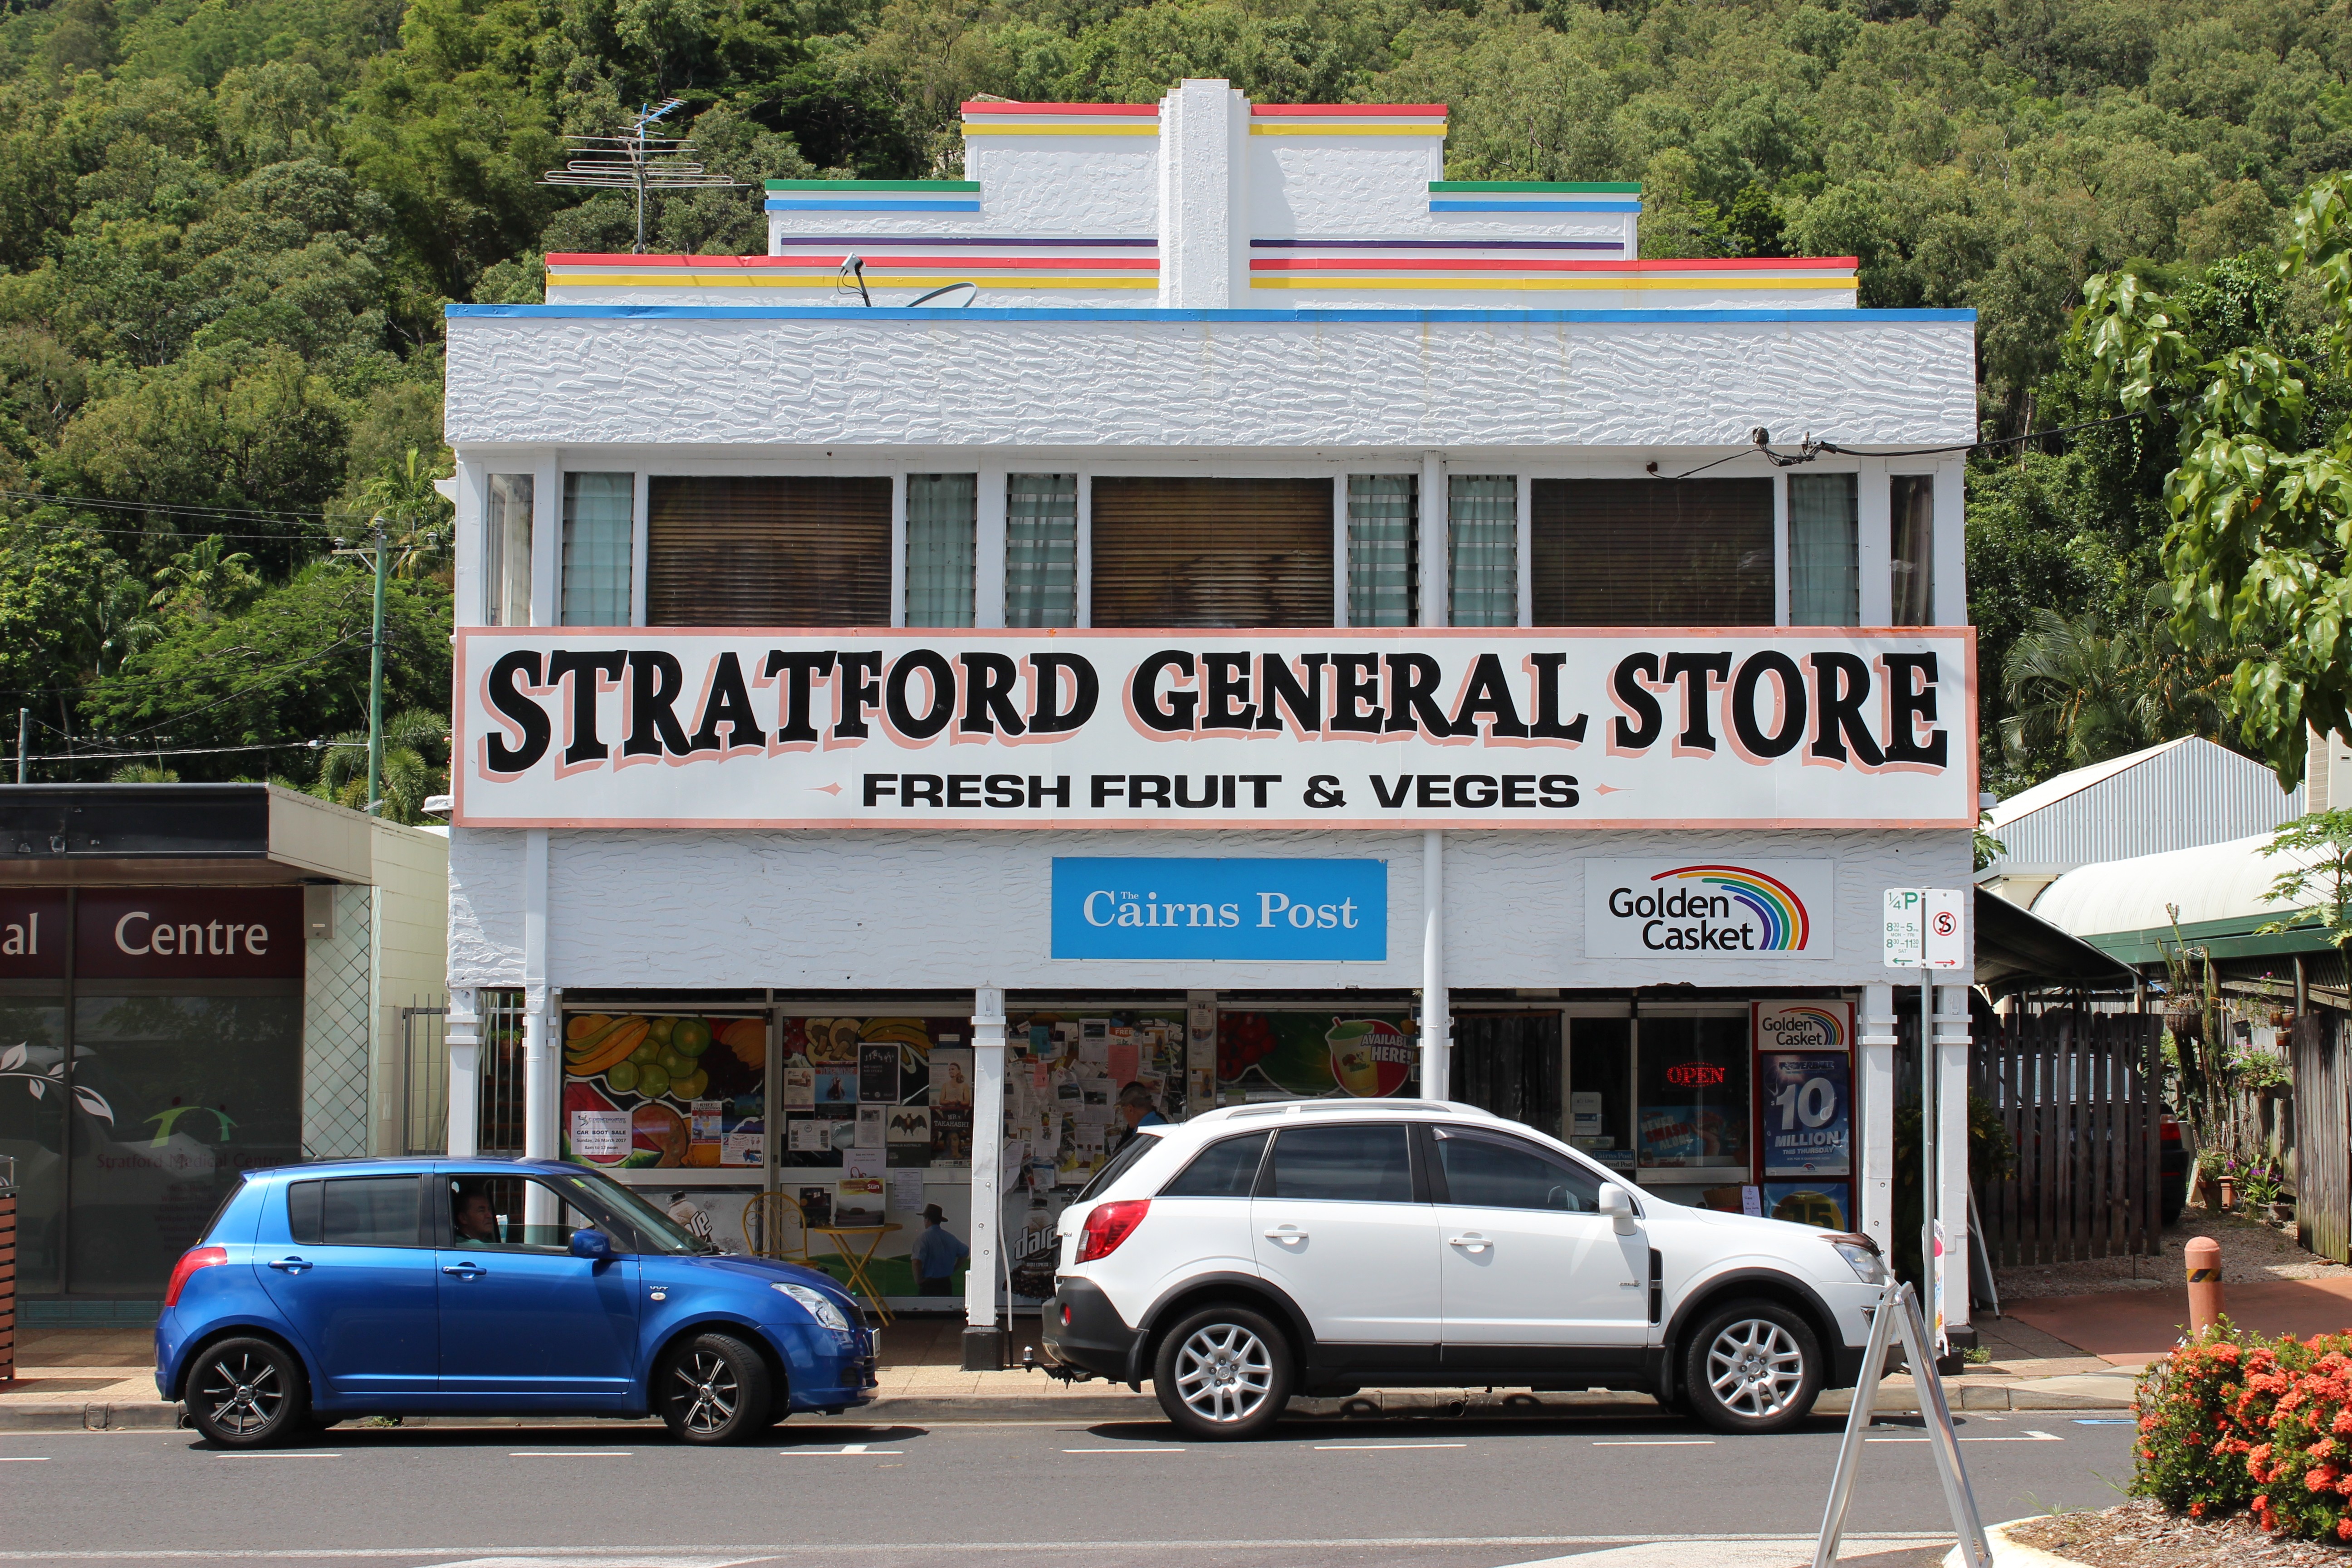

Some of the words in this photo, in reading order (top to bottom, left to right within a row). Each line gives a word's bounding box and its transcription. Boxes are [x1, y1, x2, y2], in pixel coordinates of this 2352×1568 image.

[486, 649, 1100, 773] STRATFORD
[1131, 649, 1589, 743] GENERAL
[1612, 650, 1948, 769] STORE
[863, 773, 1071, 808] FRESH
[1091, 774, 1281, 808] FRUIT
[1302, 774, 1348, 808] &
[1368, 774, 1580, 808] VEGES
[1121, 891, 1139, 900] The
[1608, 887, 1730, 918] Golden
[1083, 890, 1240, 928] Cairns
[1256, 892, 1359, 929] Post
[0, 912, 39, 955] al
[115, 911, 268, 955] Centre
[1642, 919, 1754, 950] Casket
[1762, 1017, 1812, 1031] Golden
[1360, 1034, 1411, 1048] AVAILABL
[1776, 1031, 1823, 1046] Casket
[1371, 1046, 1413, 1065] HERE!
[1666, 1066, 1726, 1083] OPEN
[1640, 1115, 1676, 1133] NEVER
[1774, 1130, 1839, 1147] MILLION
[97, 1153, 162, 1169] Stratford
[169, 1153, 227, 1168] Medical
[233, 1153, 284, 1168] Centre
[1014, 1224, 1059, 1260] dare
